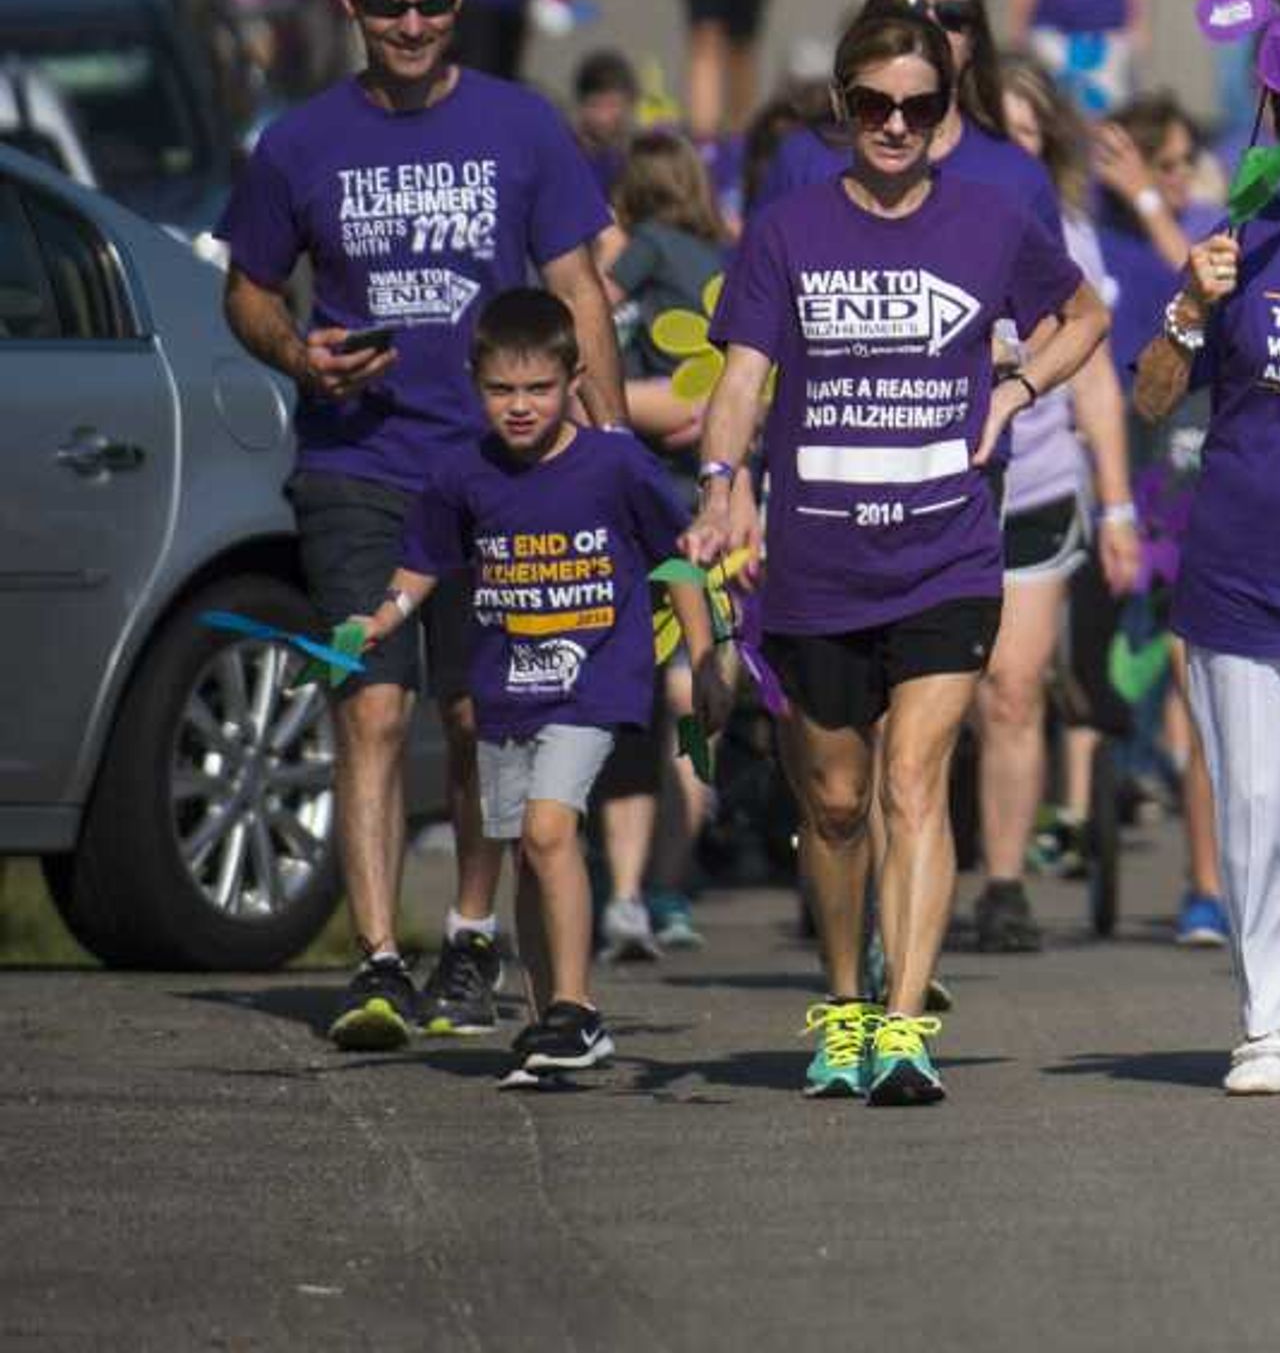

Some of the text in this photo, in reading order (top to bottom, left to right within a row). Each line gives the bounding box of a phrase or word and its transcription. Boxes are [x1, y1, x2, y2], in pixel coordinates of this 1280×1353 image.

[338, 160, 497, 194] THE END OF
[340, 186, 498, 220] ALZHEIMER'S
[342, 218, 407, 240] STARTS
[342, 237, 390, 256] WITH
[369, 270, 418, 286] WALK
[801, 270, 917, 294] WALK TO
[804, 299, 918, 322] END
[857, 377, 873, 398] A
[876, 378, 952, 399] REASON
[855, 503, 904, 525] 2014
[514, 533, 567, 556] END
[573, 529, 608, 553] OF
[548, 581, 613, 608] WITH
